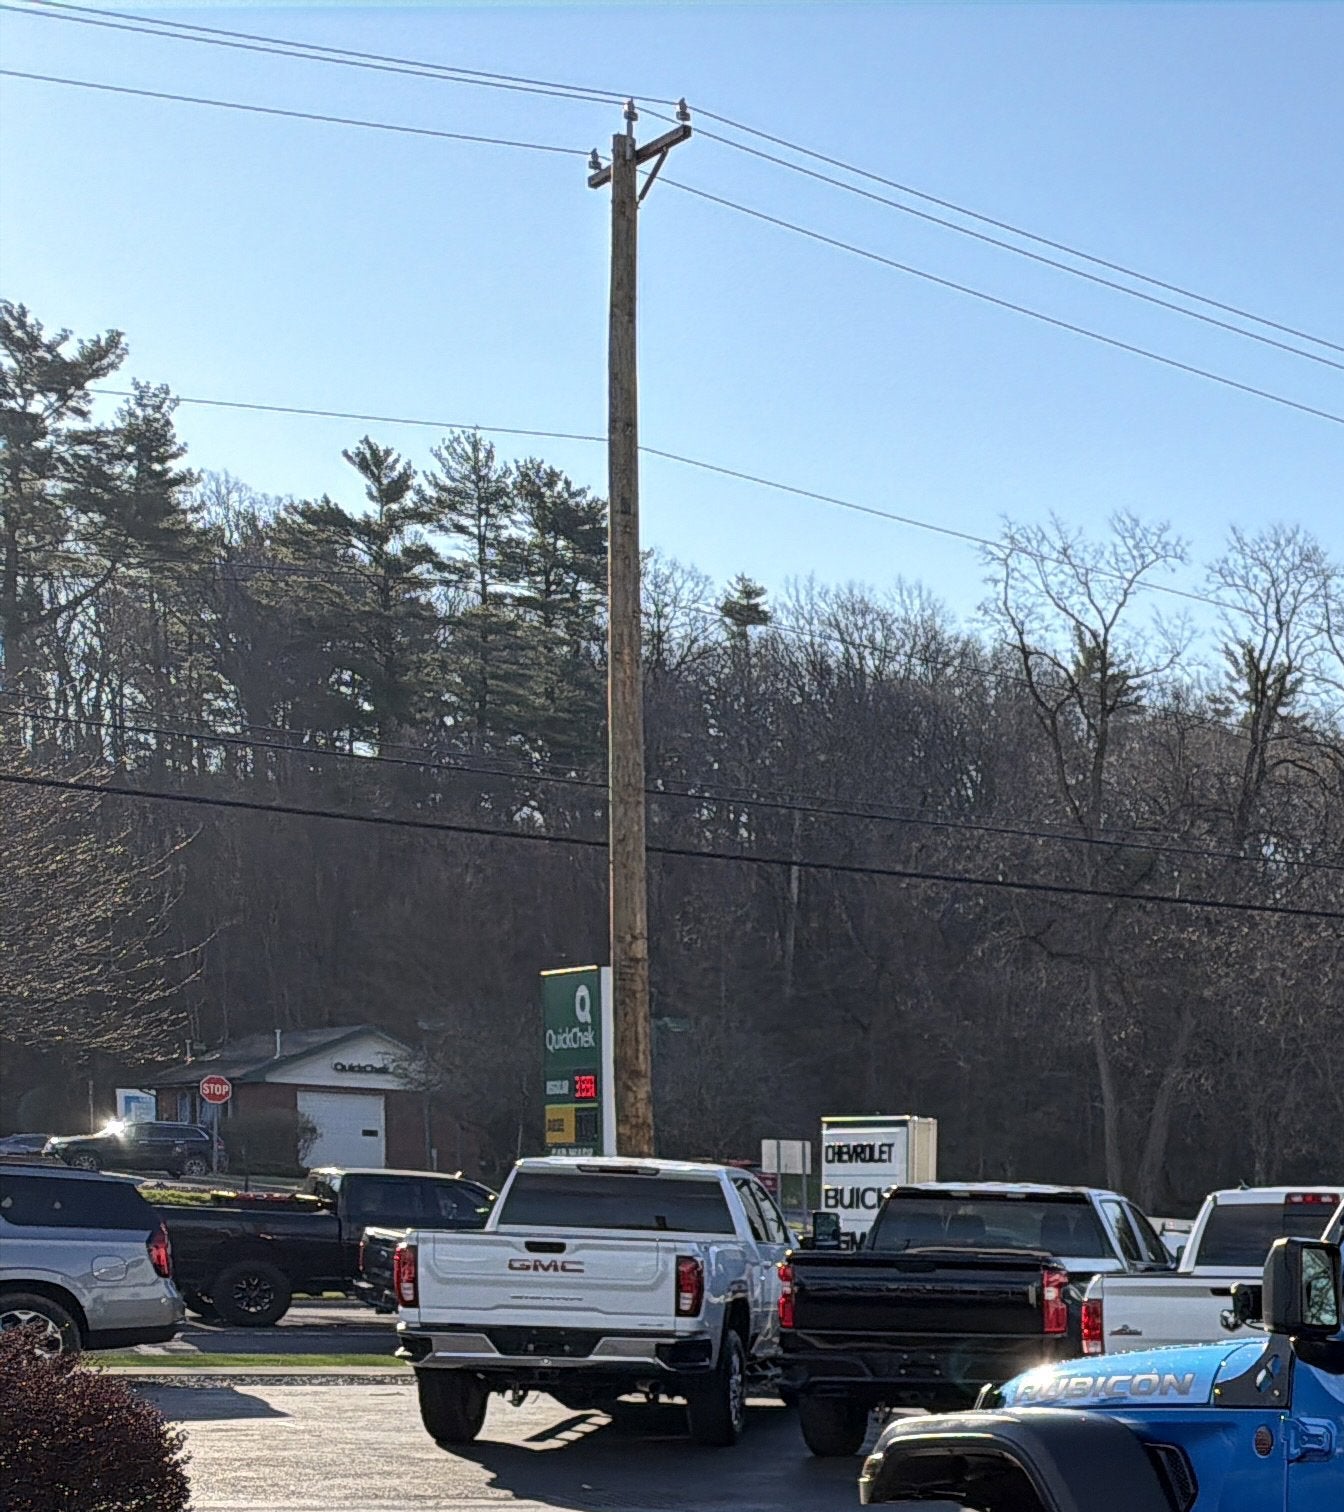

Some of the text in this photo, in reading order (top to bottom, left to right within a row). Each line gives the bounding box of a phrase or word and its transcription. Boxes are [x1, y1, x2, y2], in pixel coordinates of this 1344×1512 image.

[545, 1026, 596, 1053] QuickChek
[202, 1082, 229, 1096] STOP
[824, 1142, 895, 1164] CHEVROLET
[508, 1257, 585, 1274] GMC
[1013, 1371, 1197, 1403] RUBICON
